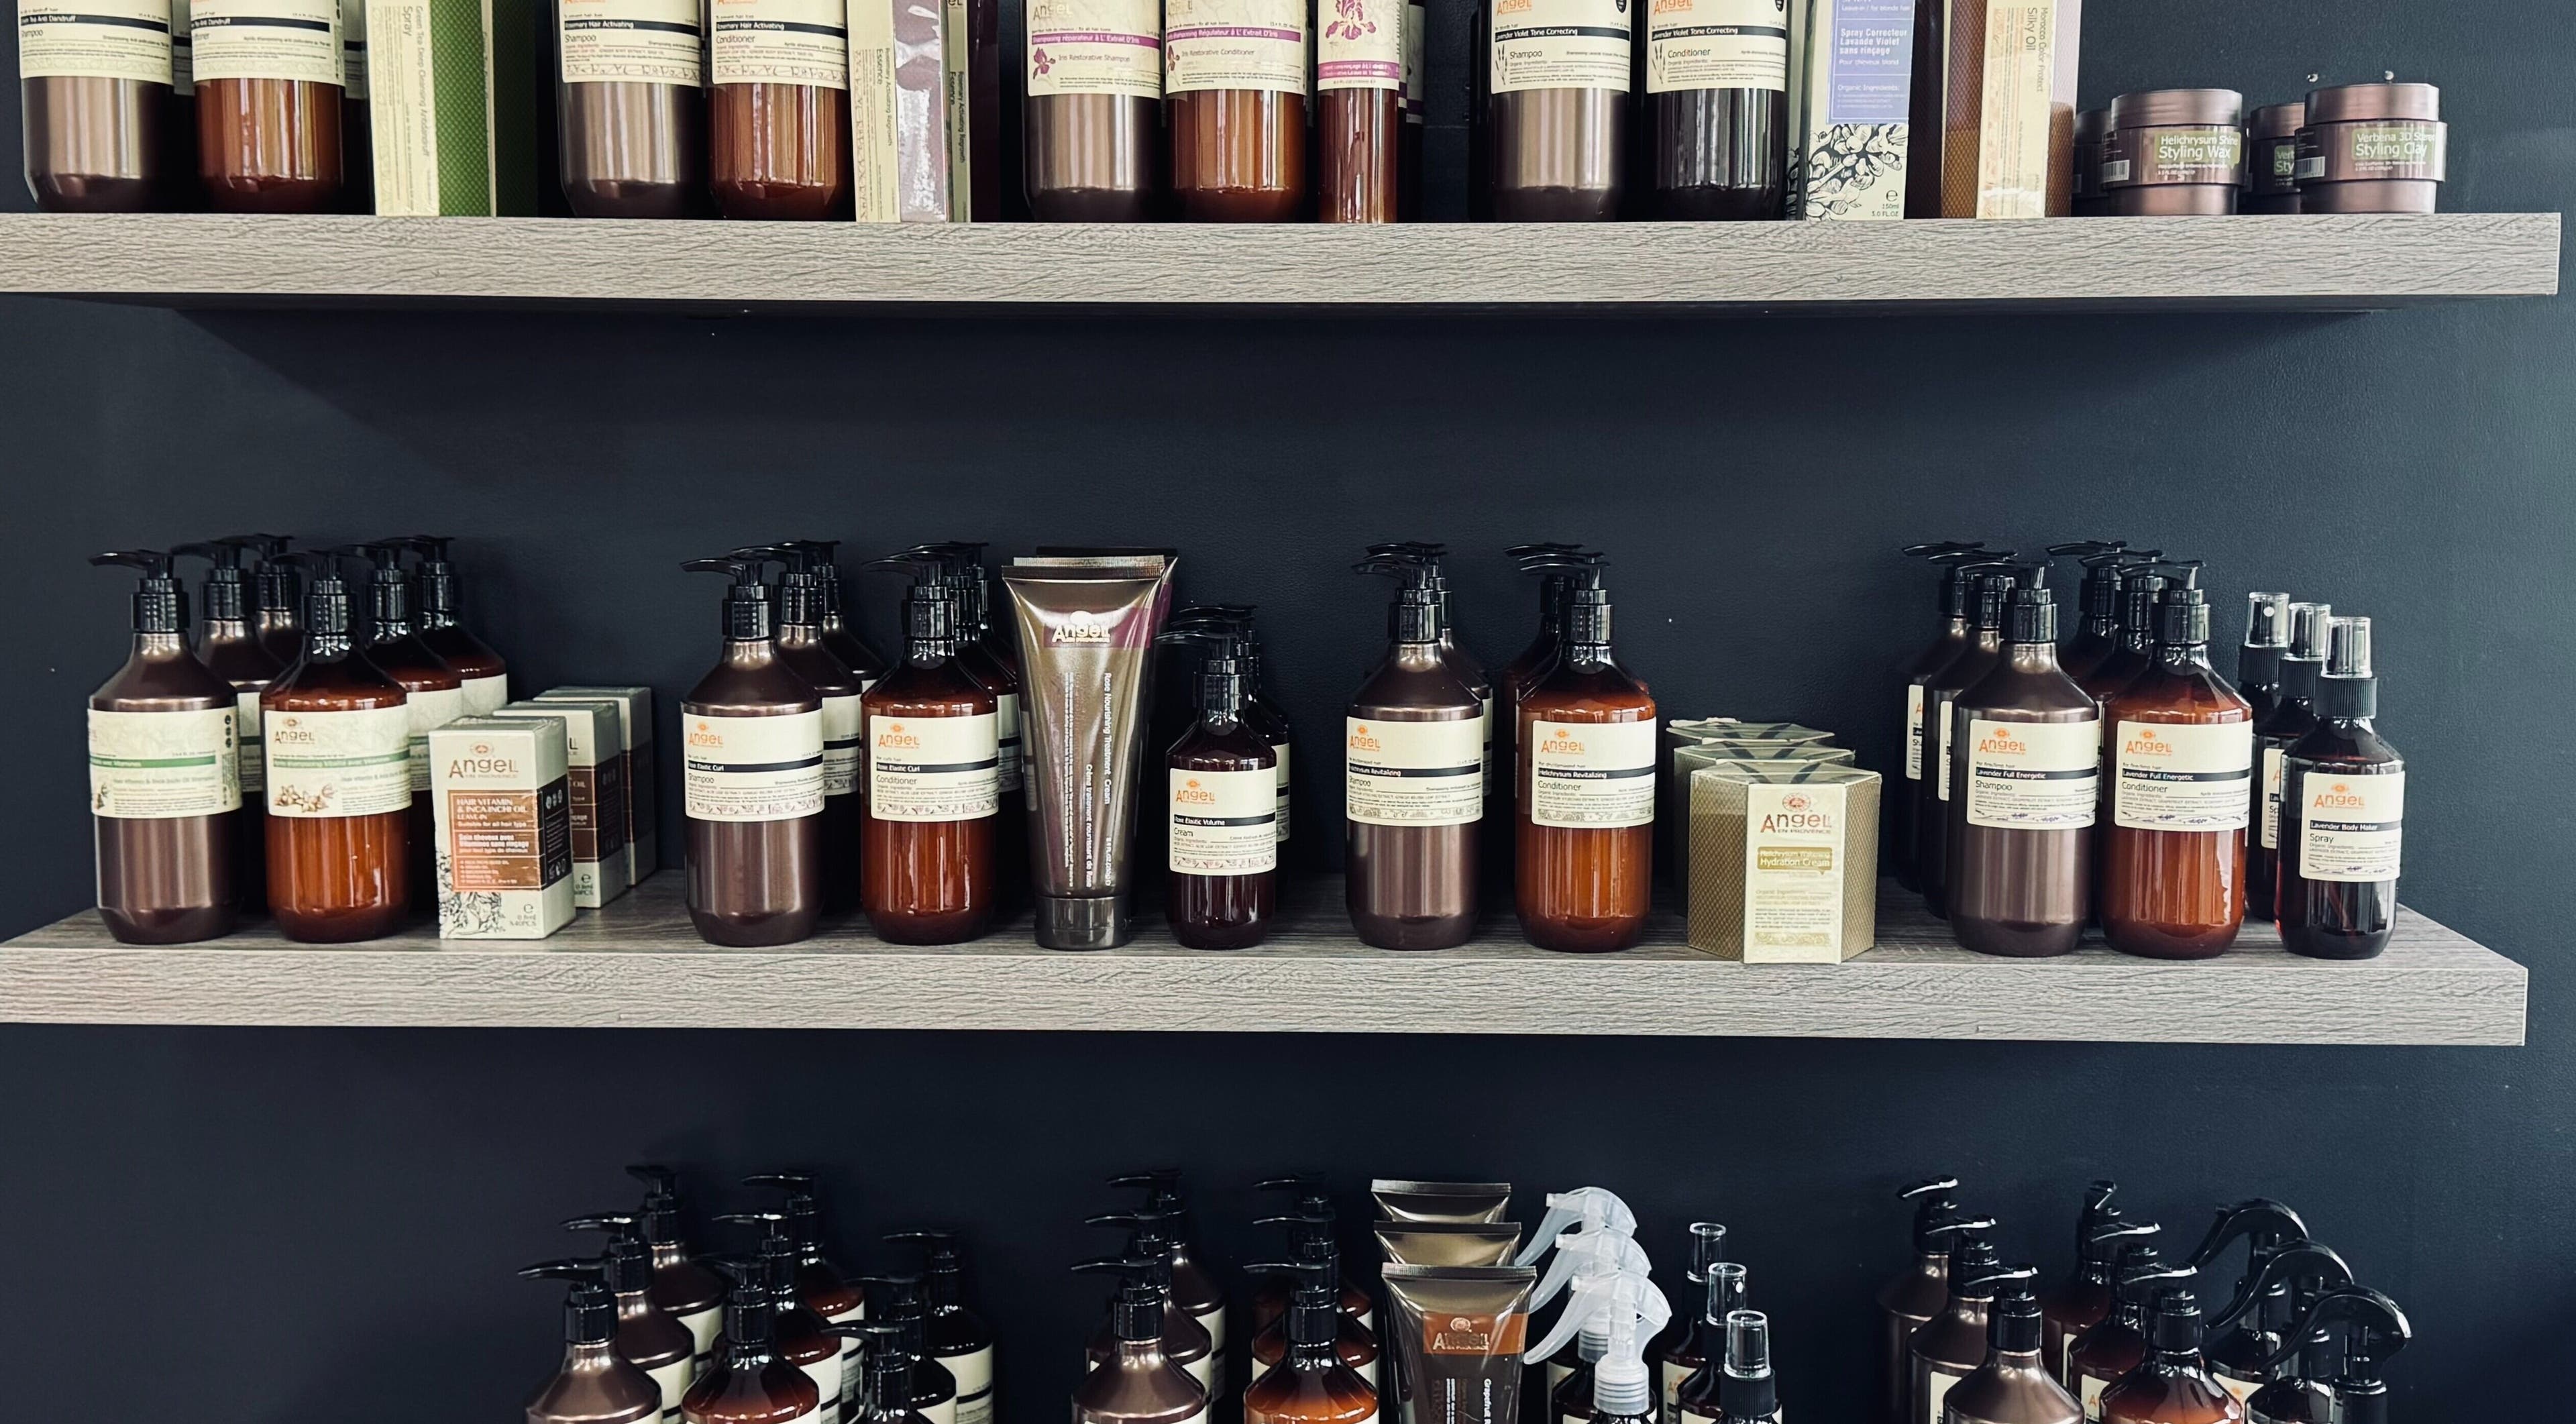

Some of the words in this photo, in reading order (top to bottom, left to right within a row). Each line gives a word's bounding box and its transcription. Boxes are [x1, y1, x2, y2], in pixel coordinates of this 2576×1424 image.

[402, 5, 414, 36] Spray
[2025, 7, 2037, 32] Silky
[2039, 7, 2048, 40] Morocco
[602, 21, 634, 29] Activating
[753, 22, 785, 31] Activating
[1546, 28, 1578, 36] Correcting
[1707, 27, 1738, 35] Correcting
[1841, 28, 1863, 38] Spray
[1866, 28, 1907, 36] Correcteur
[716, 35, 755, 43] Conditioner
[2026, 36, 2037, 51] Oil
[1509, 50, 1542, 59] Shampoo
[1668, 48, 1711, 58] Conditioner
[1860, 47, 1890, 56] rinçage
[2038, 42, 2046, 62] Color
[2037, 65, 2045, 92] Protect
[1837, 85, 1862, 93] Organic
[2161, 135, 2217, 146] Helichrysum
[2219, 135, 2239, 146] Shine
[2357, 133, 2396, 143] Verbena
[2399, 133, 2411, 141] 3D
[2159, 146, 2203, 161] Styling
[2207, 146, 2231, 159] Wax
[2355, 143, 2400, 158] Styling
[2404, 142, 2428, 156] Clay
[1104, 672, 1112, 692] Rose
[1103, 693, 1112, 734] Nourishing
[2123, 769, 2148, 778] Lavender
[876, 775, 917, 785] Conditioner
[1976, 779, 2012, 791] Shampoo
[1538, 780, 1581, 791] Conditioner
[2122, 781, 2167, 793] Conditioner
[2311, 821, 2340, 830] Lavender
[1174, 827, 1193, 837] Cream
[2309, 833, 2334, 844] Spray
[1760, 858, 1800, 868] Hydration
[1802, 858, 1830, 867] Cream
[1483, 1378, 1492, 1417] Grapefruit
